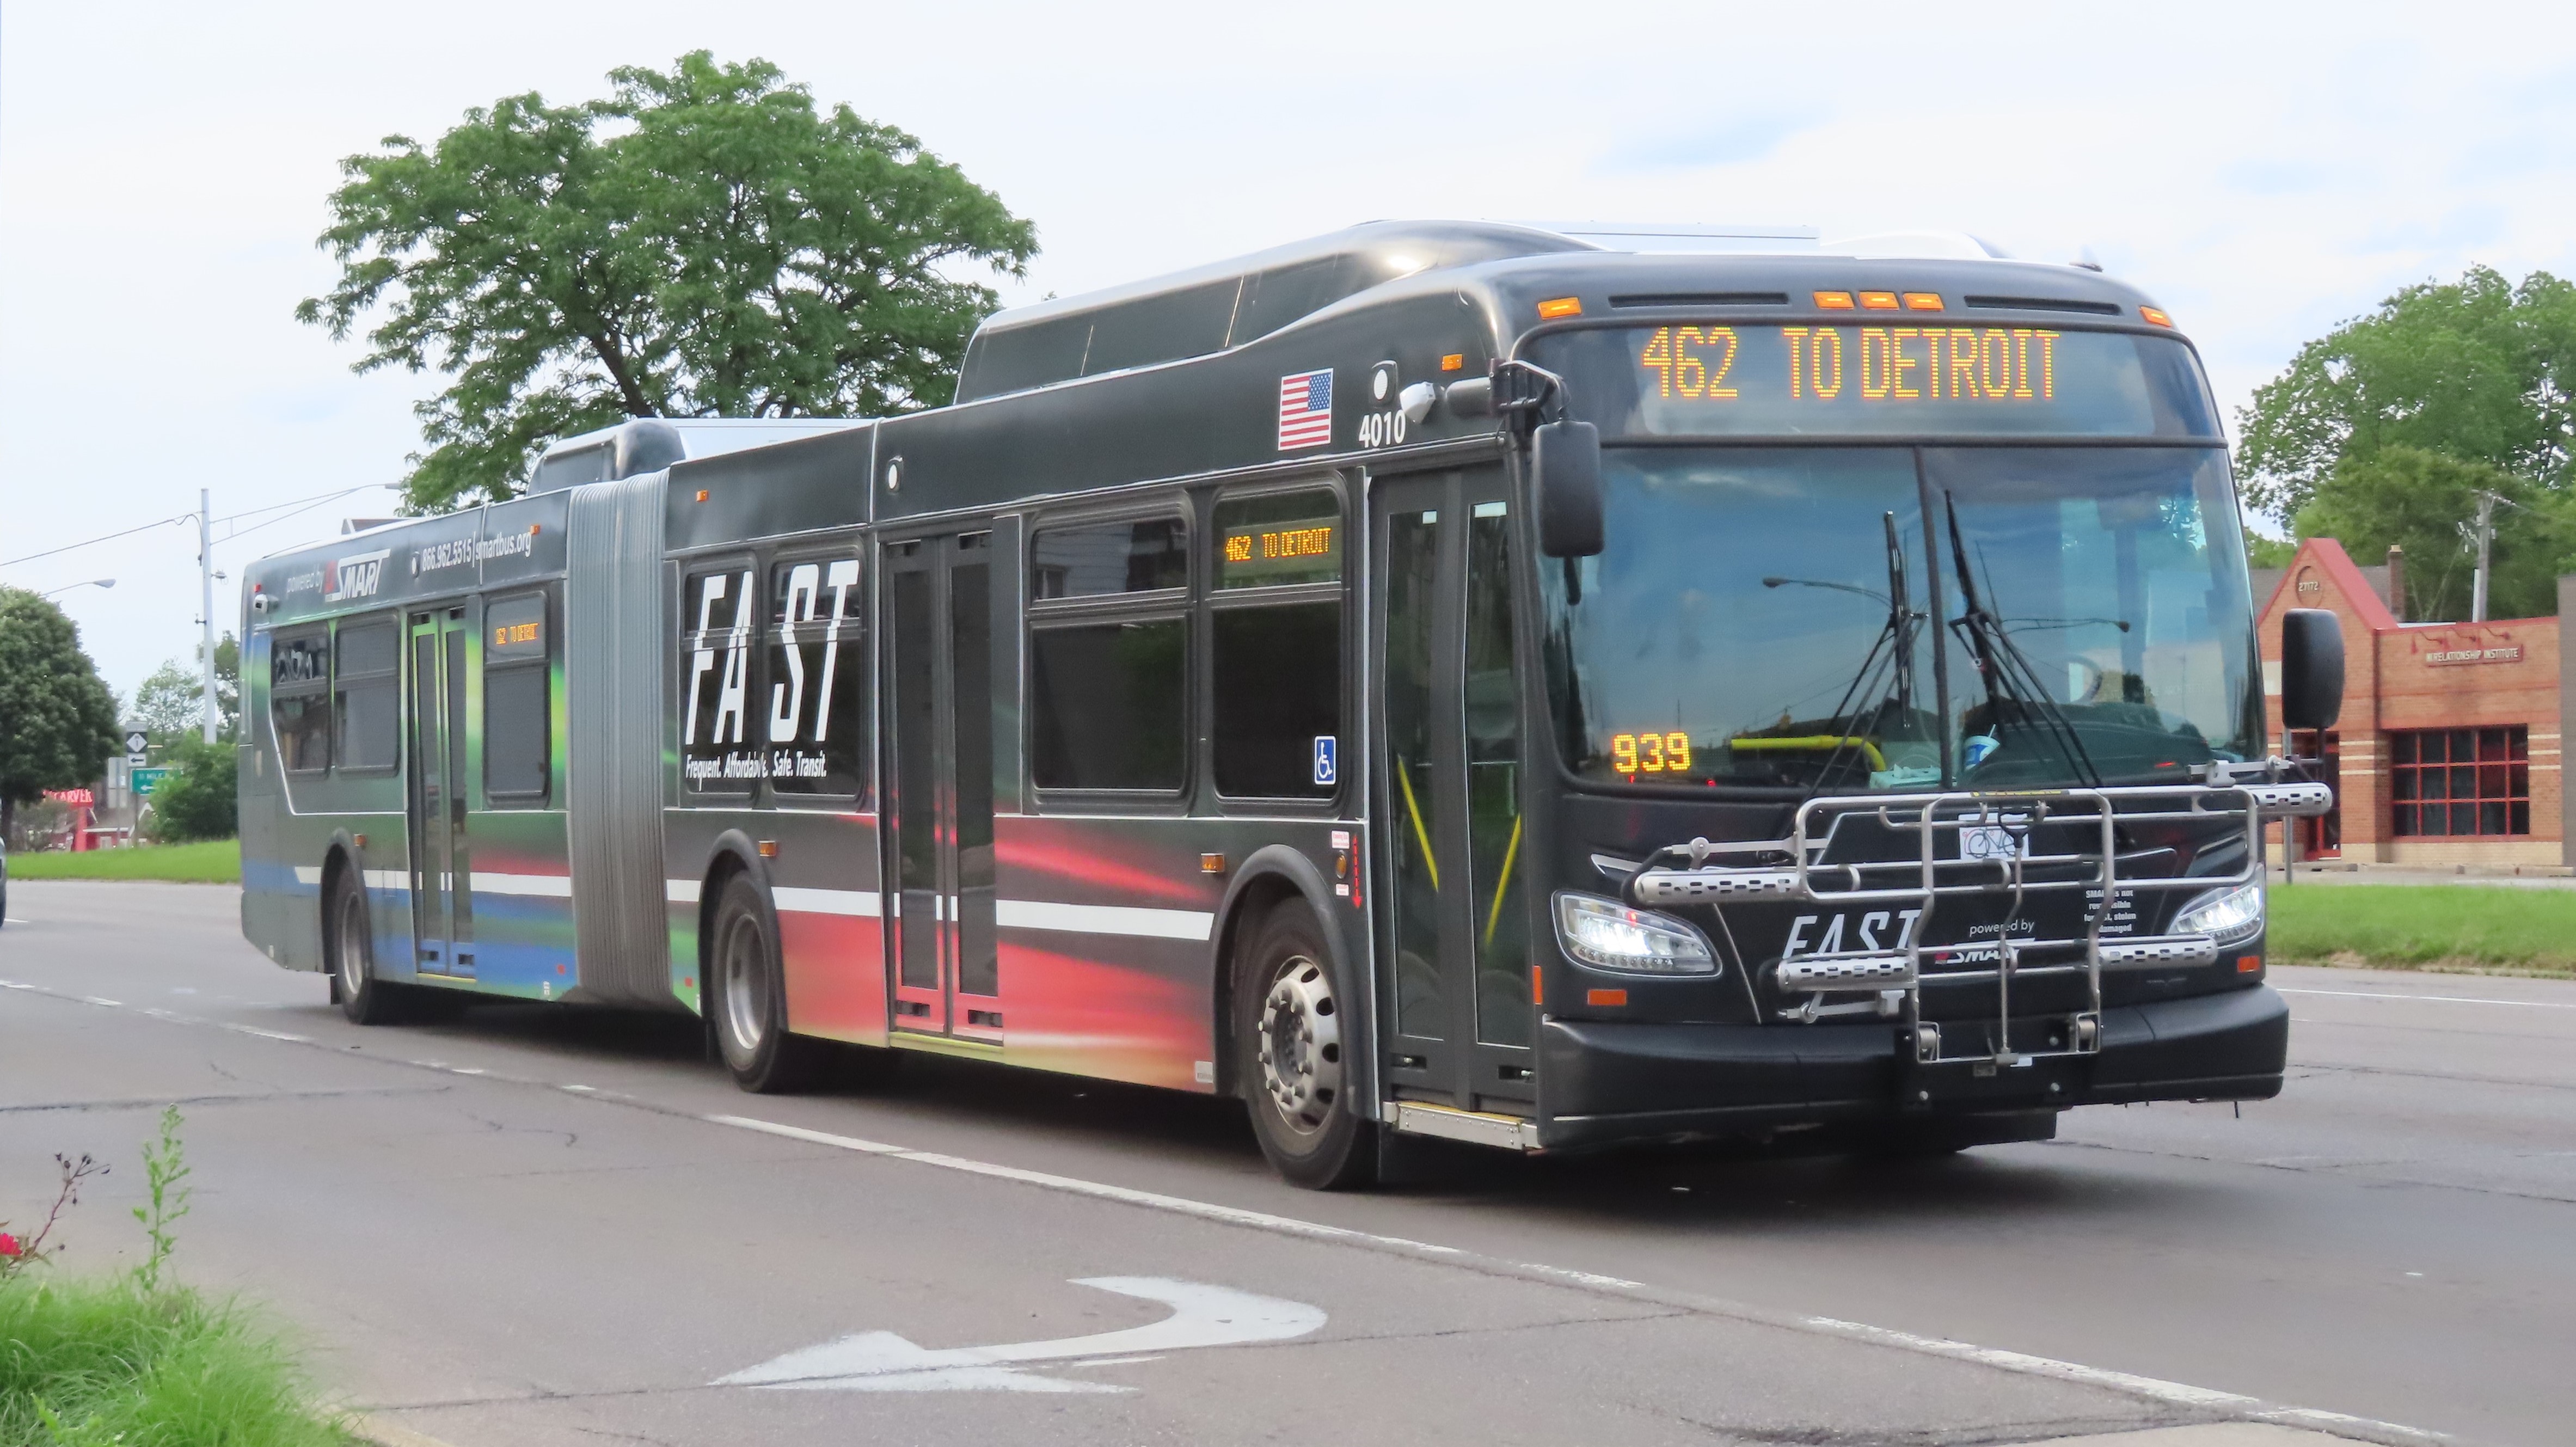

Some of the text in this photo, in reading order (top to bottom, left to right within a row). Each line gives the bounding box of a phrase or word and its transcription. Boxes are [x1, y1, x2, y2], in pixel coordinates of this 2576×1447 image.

[1642, 327, 2060, 398] 462 TO DETROIT
[1359, 409, 1406, 448] 4010
[422, 531, 532, 572] 866.962.5515 smartbus.org
[1226, 528, 1332, 561] 462 TO DETROIT
[325, 548, 391, 603] SMART
[685, 560, 860, 745] FAST
[2483, 648, 2519, 659] INSTITUTE
[685, 753, 721, 792] Frequent.
[772, 749, 793, 777] Safe.
[796, 750, 827, 777] Transit.
[1614, 732, 1690, 772] 939
[1782, 909, 1922, 959] FAST
[2021, 919, 2034, 933] by
